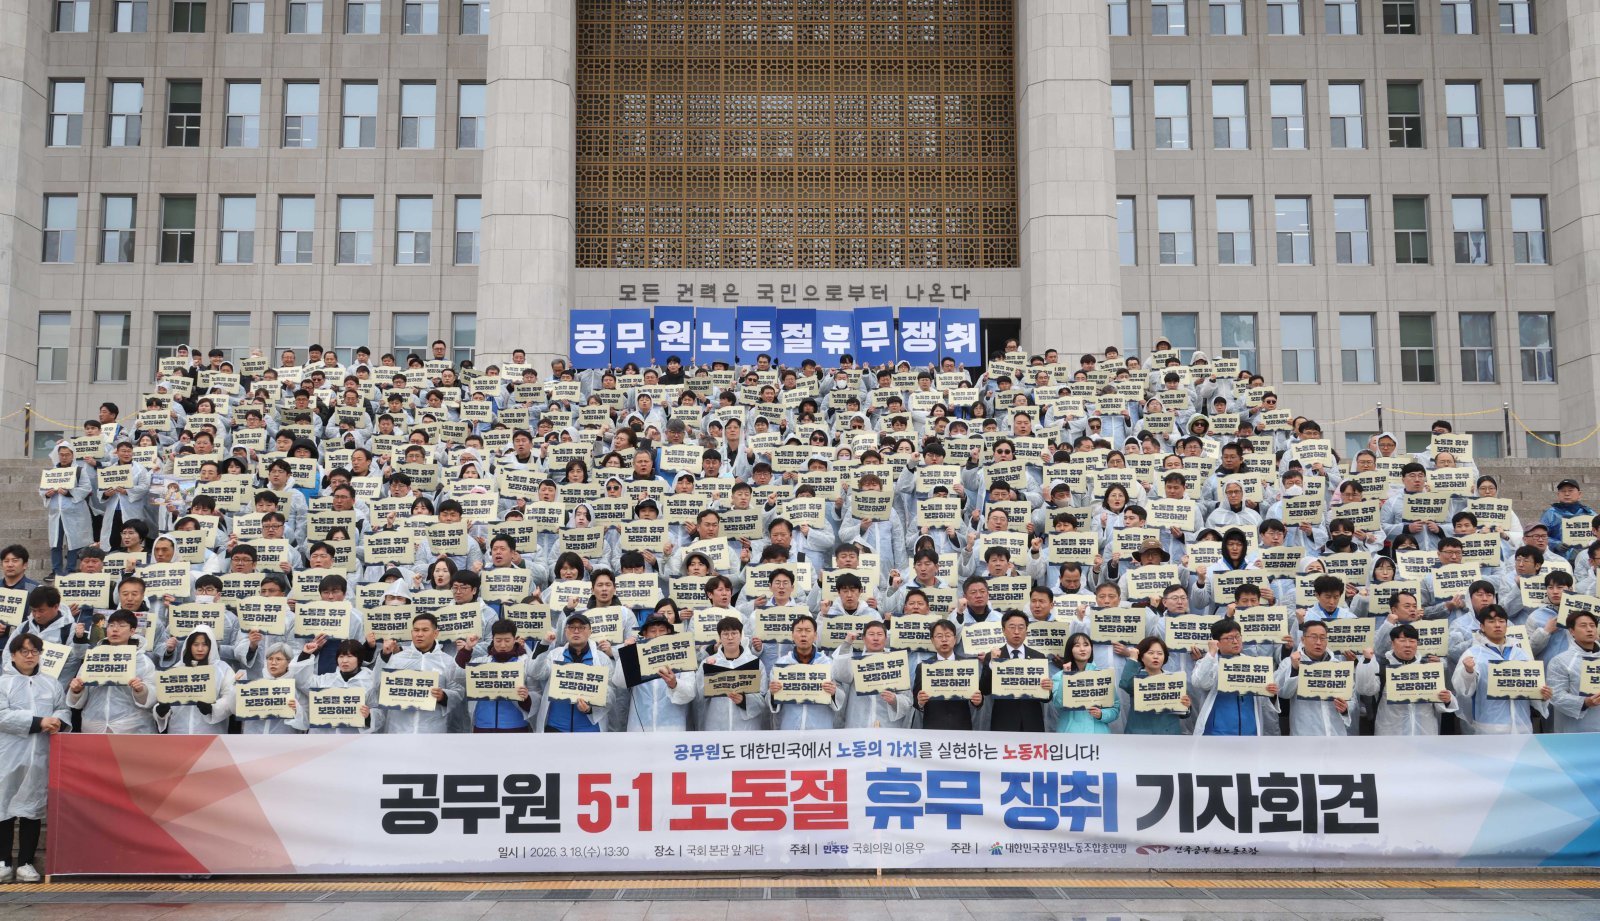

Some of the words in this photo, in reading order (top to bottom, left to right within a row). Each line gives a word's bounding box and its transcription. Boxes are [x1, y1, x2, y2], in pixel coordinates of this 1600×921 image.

[619, 284, 660, 302] 모든
[677, 283, 739, 303] 권력은
[757, 284, 887, 303] 국민으로부터
[907, 283, 970, 302] 나온다
[664, 449, 685, 457] 노동절
[667, 456, 696, 464] 보장하라!
[1151, 503, 1174, 512] 노동절
[1176, 505, 1191, 513] 휴무
[1286, 501, 1307, 509] 노동절
[1308, 500, 1322, 508] 휴무
[1289, 508, 1319, 517] 보장하라!
[1410, 506, 1444, 514] 보장하라!
[1154, 512, 1188, 521] 보장하라!
[624, 526, 647, 534] 노동절
[649, 526, 665, 534] 휴무
[367, 538, 391, 546] 노동절
[393, 537, 409, 545] 휴무
[1052, 538, 1076, 546] 노동절
[1079, 538, 1095, 546] 휴무
[371, 546, 406, 555] 보장하라!
[1056, 547, 1091, 555] 보장하라!
[485, 575, 510, 583] 노동절
[512, 575, 528, 583] 휴무
[59, 580, 85, 588] 노동절
[88, 580, 105, 588] 휴무
[489, 584, 524, 592] 보장하라!
[63, 589, 101, 597] 보장하라!
[299, 608, 326, 617] 노동절
[328, 608, 346, 617] 휴무
[1094, 614, 1121, 623] 노동절
[1124, 615, 1141, 624] 휴무
[1239, 614, 1265, 622] 노동절
[1267, 613, 1284, 622] 휴무
[302, 618, 342, 627] 보장하라!
[1098, 624, 1137, 633] 보장하라!
[1244, 623, 1281, 632] 보장하라!
[642, 643, 670, 656] 노동절
[672, 640, 690, 650] 휴무
[648, 650, 688, 665] 보장하라!
[857, 661, 884, 673] 노동절
[886, 659, 905, 669] 휴무
[1224, 663, 1250, 673] 노동절
[1252, 664, 1270, 673] 휴무
[470, 671, 498, 679] 노동절
[501, 670, 519, 679] 휴무
[926, 668, 954, 677] 노동절
[956, 668, 975, 677] 휴무
[996, 666, 1024, 675] 노동절
[1027, 667, 1045, 676] 휴무
[1304, 669, 1331, 678] 노동절
[1333, 669, 1351, 678] 휴무
[1493, 668, 1520, 677] 노동절
[1523, 668, 1541, 677] 휴무
[160, 674, 188, 684] 노동절
[191, 674, 210, 683] 휴무
[556, 669, 584, 681] 노동절
[586, 673, 604, 683] 휴무
[778, 672, 806, 681] 노동절
[808, 672, 827, 681] 휴무
[863, 670, 902, 682] 보장하라!
[1228, 674, 1266, 684] 보장하라!
[1391, 672, 1419, 681] 노동절
[1422, 671, 1440, 680] 휴무
[385, 676, 413, 686] 노동절
[416, 678, 434, 688] 휴무
[475, 680, 515, 689] 보장하라!
[930, 678, 971, 687] 보장하라!
[1001, 677, 1041, 686] 보장하라!
[1068, 678, 1093, 688] 노동절
[1096, 677, 1113, 686] 휴무
[1139, 682, 1165, 691] 노동절
[1167, 681, 1185, 690] 휴무
[1308, 679, 1347, 688] 보장하라!
[1396, 681, 1437, 691] 보장하라!
[1497, 679, 1537, 688] 보장하라!
[165, 684, 206, 694] 보장하라!
[558, 680, 599, 693] 보장하라!
[782, 682, 823, 691] 보장하라!
[240, 687, 269, 697] 노동절
[272, 686, 291, 696] 휴무
[388, 687, 429, 698] 보장하라!
[1072, 687, 1109, 698] 보장하라!
[1142, 691, 1181, 701] 보장하라!
[244, 697, 286, 707] 보장하라!
[313, 696, 340, 704] 노동절
[343, 695, 360, 704] 휴무
[318, 706, 357, 715] 보장하라!
[674, 744, 735, 760] 공무원도
[740, 741, 831, 759] 대한민국에서
[837, 740, 881, 757] 노동의
[887, 741, 932, 759] 가치를
[938, 742, 998, 760] 실현하는
[1003, 744, 1099, 761] 노동자입니다!
[380, 773, 561, 834] 공무원
[670, 769, 848, 831] 노동절
[865, 768, 983, 829] 휴무
[1001, 771, 1118, 832] 쟁취
[1136, 772, 1379, 834] 기자회견
[498, 847, 518, 858] 일시
[604, 847, 629, 856] 13:30
[655, 845, 675, 857] 장소
[687, 845, 706, 856] 국회
[709, 845, 729, 856] 본관
[731, 844, 741, 856] 앞
[744, 845, 764, 855] 계단
[790, 844, 809, 855] 주최
[823, 845, 849, 854] 민주당
[852, 843, 893, 855] 국회의원
[895, 842, 925, 854] 이용우
[951, 843, 971, 854] 주관
[1005, 842, 1127, 854] 대한민국공무원노동조합총연맹
